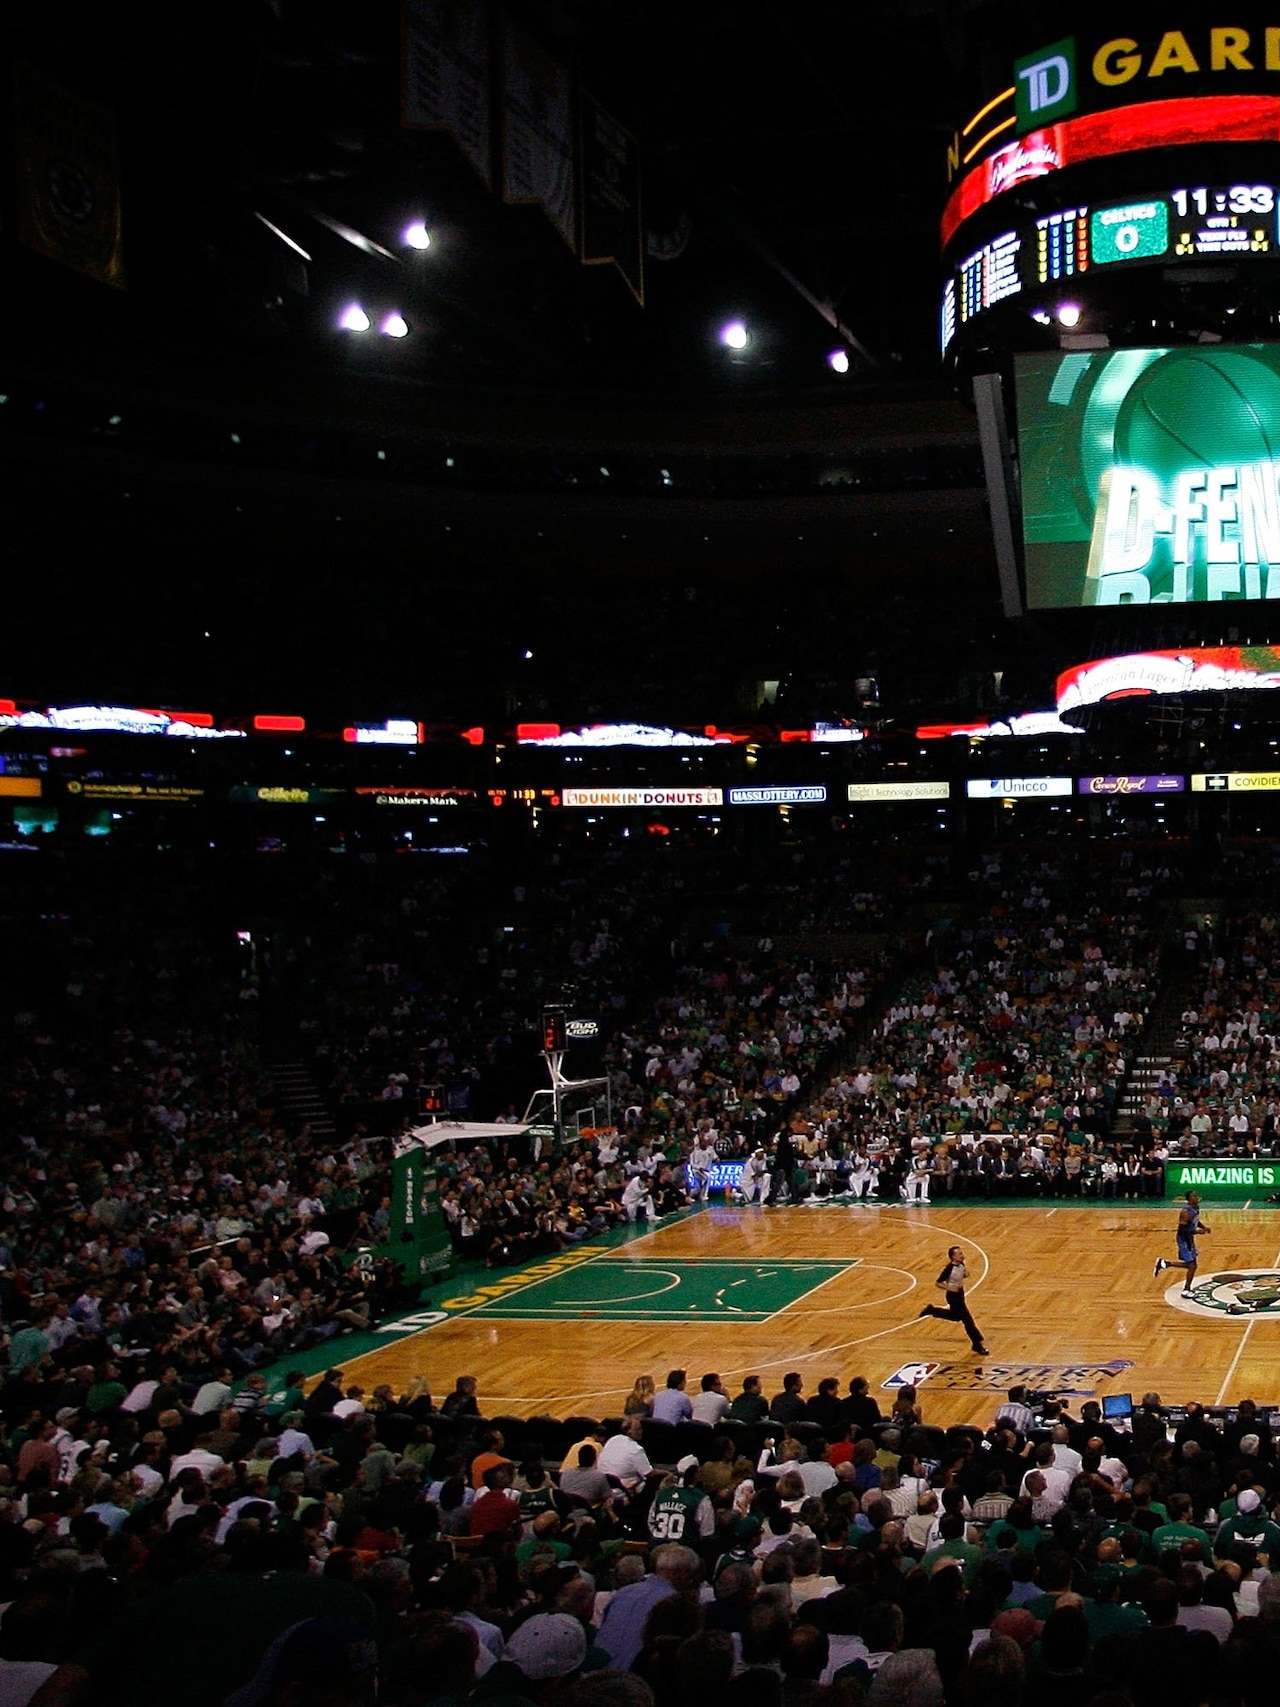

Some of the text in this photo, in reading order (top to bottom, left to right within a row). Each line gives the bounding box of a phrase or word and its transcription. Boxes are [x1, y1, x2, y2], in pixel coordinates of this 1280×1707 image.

[1019, 55, 1070, 112] TD
[1171, 185, 1275, 217] 11:33
[1116, 226, 1139, 253] 0
[733, 788, 823, 801] MASSLOTTERY.COM
[1003, 778, 1048, 793] Unicco
[388, 796, 458, 806] Maker's Mark
[579, 792, 704, 805] DUNKIN' DONUTS
[1180, 1166, 1275, 1184] AMAZING IS
[440, 1246, 610, 1309] GARDEN
[652, 1512, 686, 1540] 30
